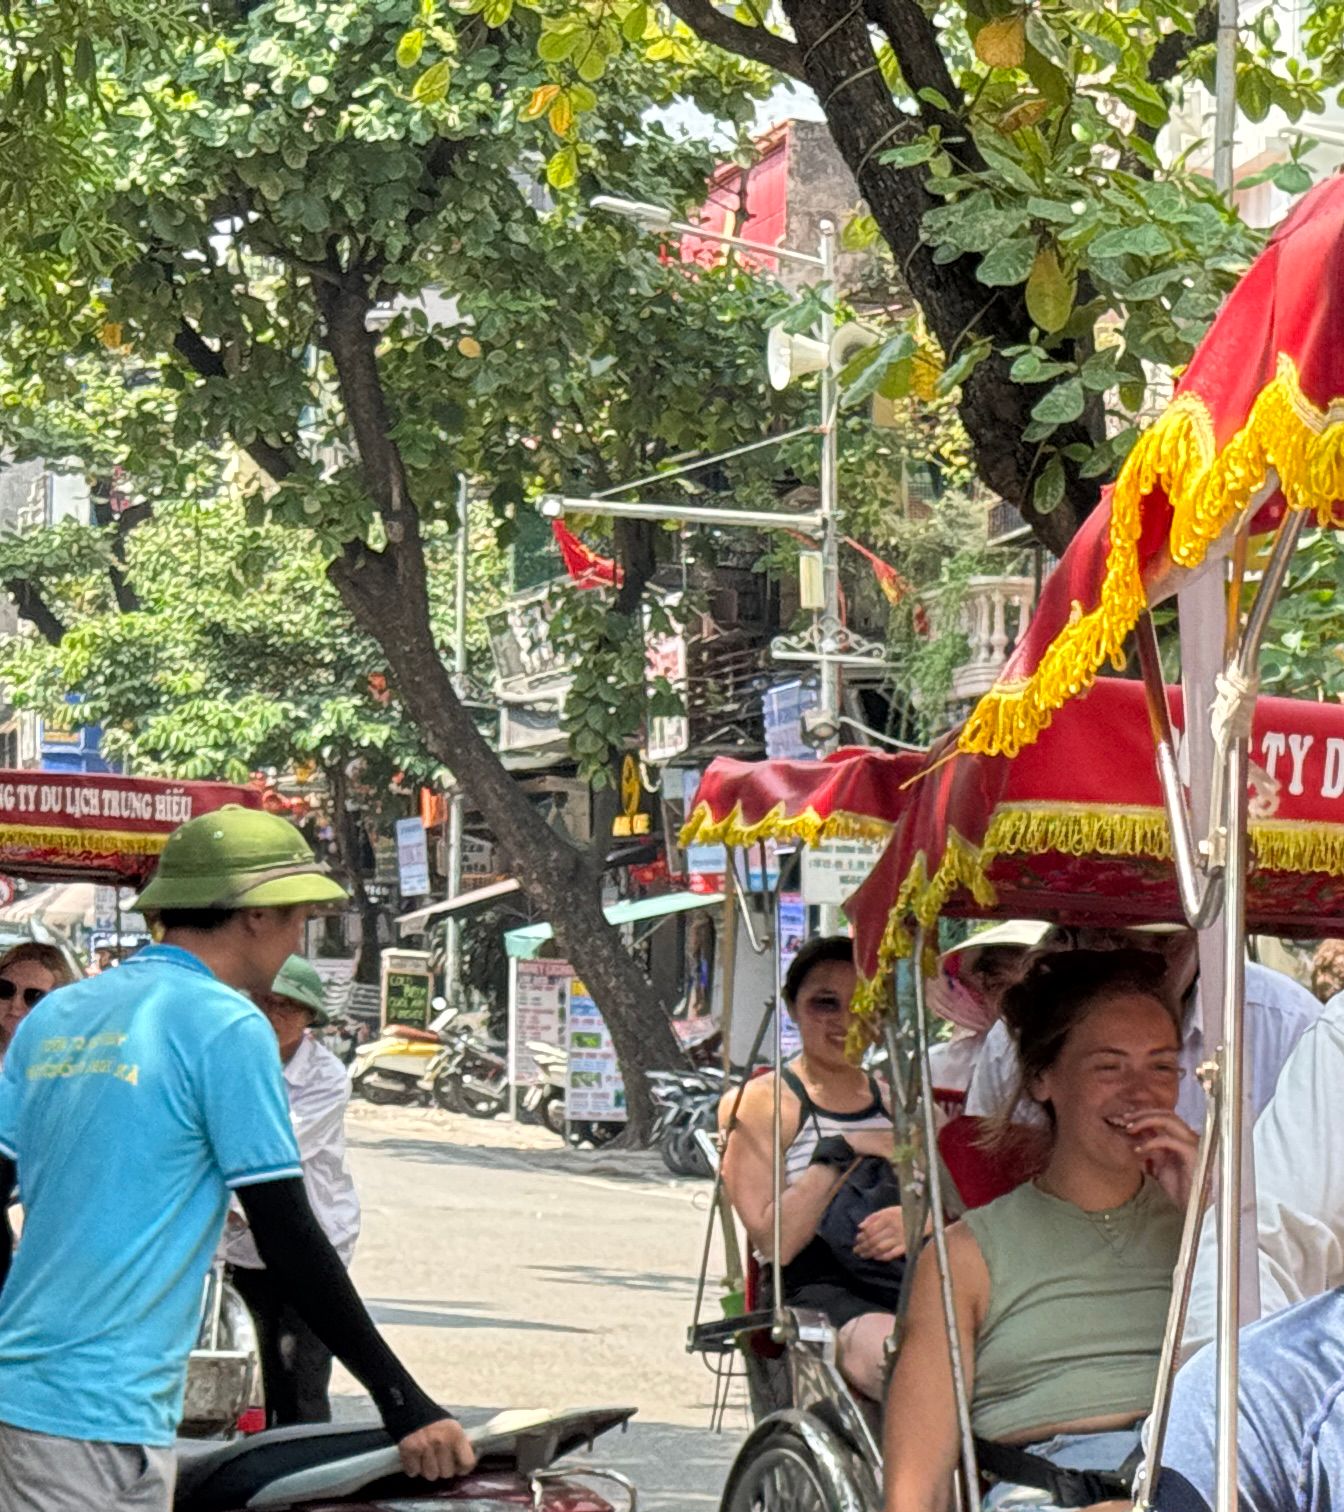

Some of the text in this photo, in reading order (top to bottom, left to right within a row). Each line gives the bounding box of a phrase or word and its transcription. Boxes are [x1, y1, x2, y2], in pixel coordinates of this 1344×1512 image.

[1262, 731, 1314, 796] TY
[17, 785, 38, 812] TY
[40, 786, 62, 813] DU
[65, 787, 100, 819] LỊCH
[102, 789, 152, 820] TRUNG
